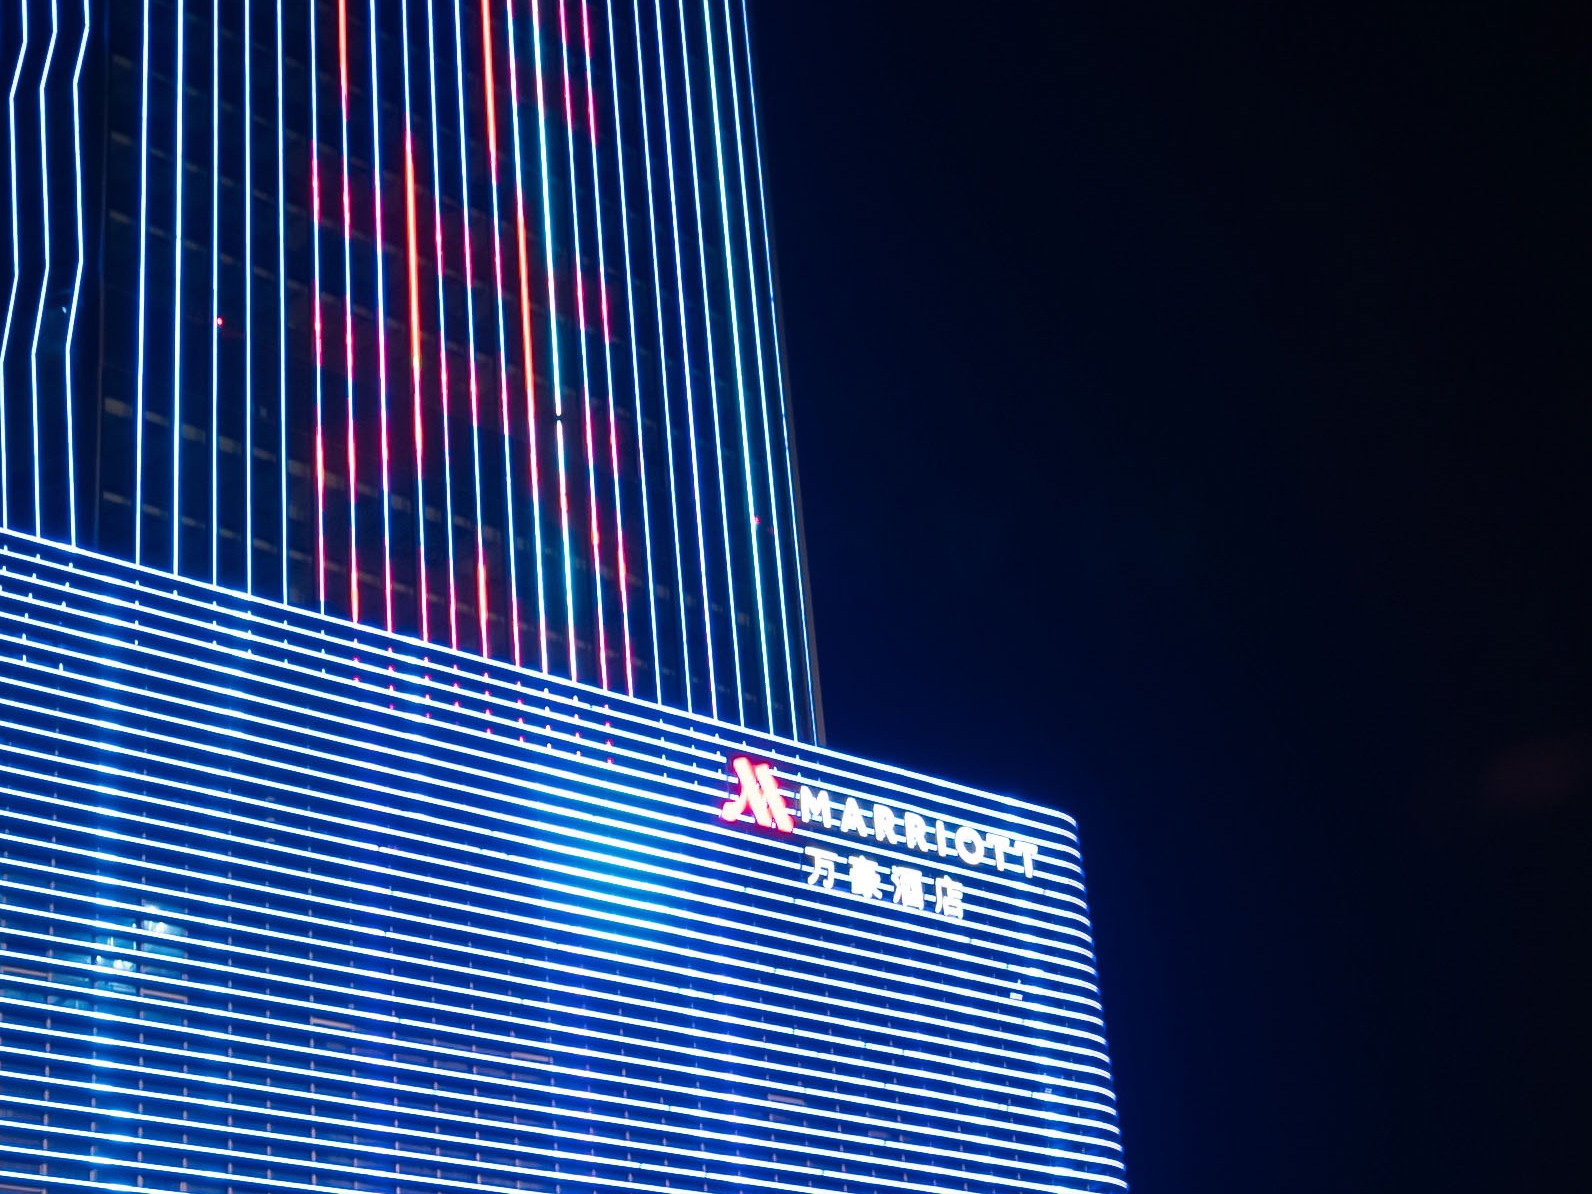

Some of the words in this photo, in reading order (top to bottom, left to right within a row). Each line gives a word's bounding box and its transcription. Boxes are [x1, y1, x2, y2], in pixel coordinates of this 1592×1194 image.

[799, 784, 1039, 879] MARRIOTT
[805, 845, 965, 920] 万豪酒店
